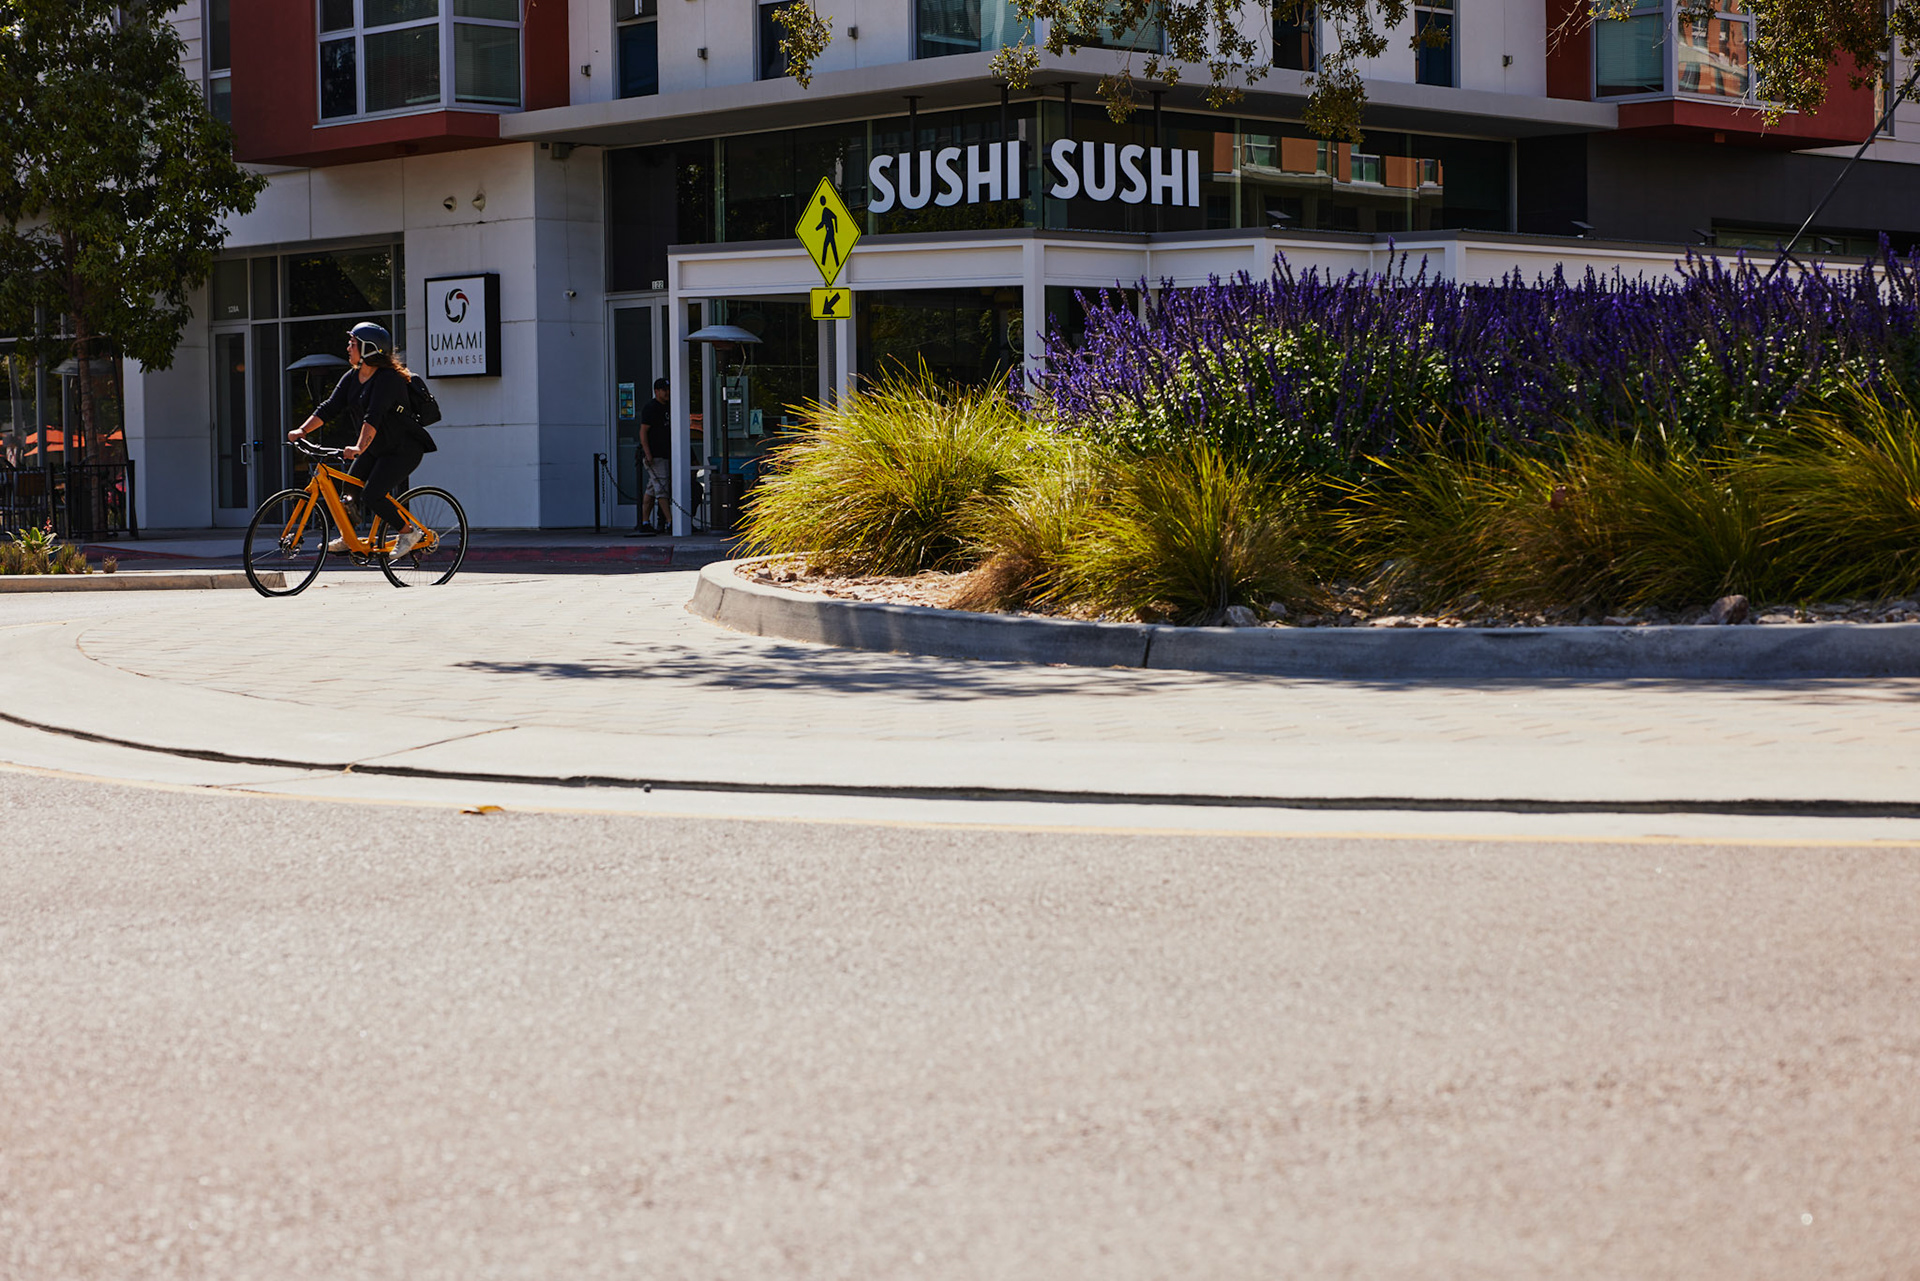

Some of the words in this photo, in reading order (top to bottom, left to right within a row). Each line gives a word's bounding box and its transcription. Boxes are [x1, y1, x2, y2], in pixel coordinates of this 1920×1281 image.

[868, 140, 1021, 214] SUSHI
[1050, 138, 1200, 207] SUSHI
[430, 331, 483, 352] UMAMI
[431, 355, 483, 367] JAPANESE
[752, 413, 760, 426] A
